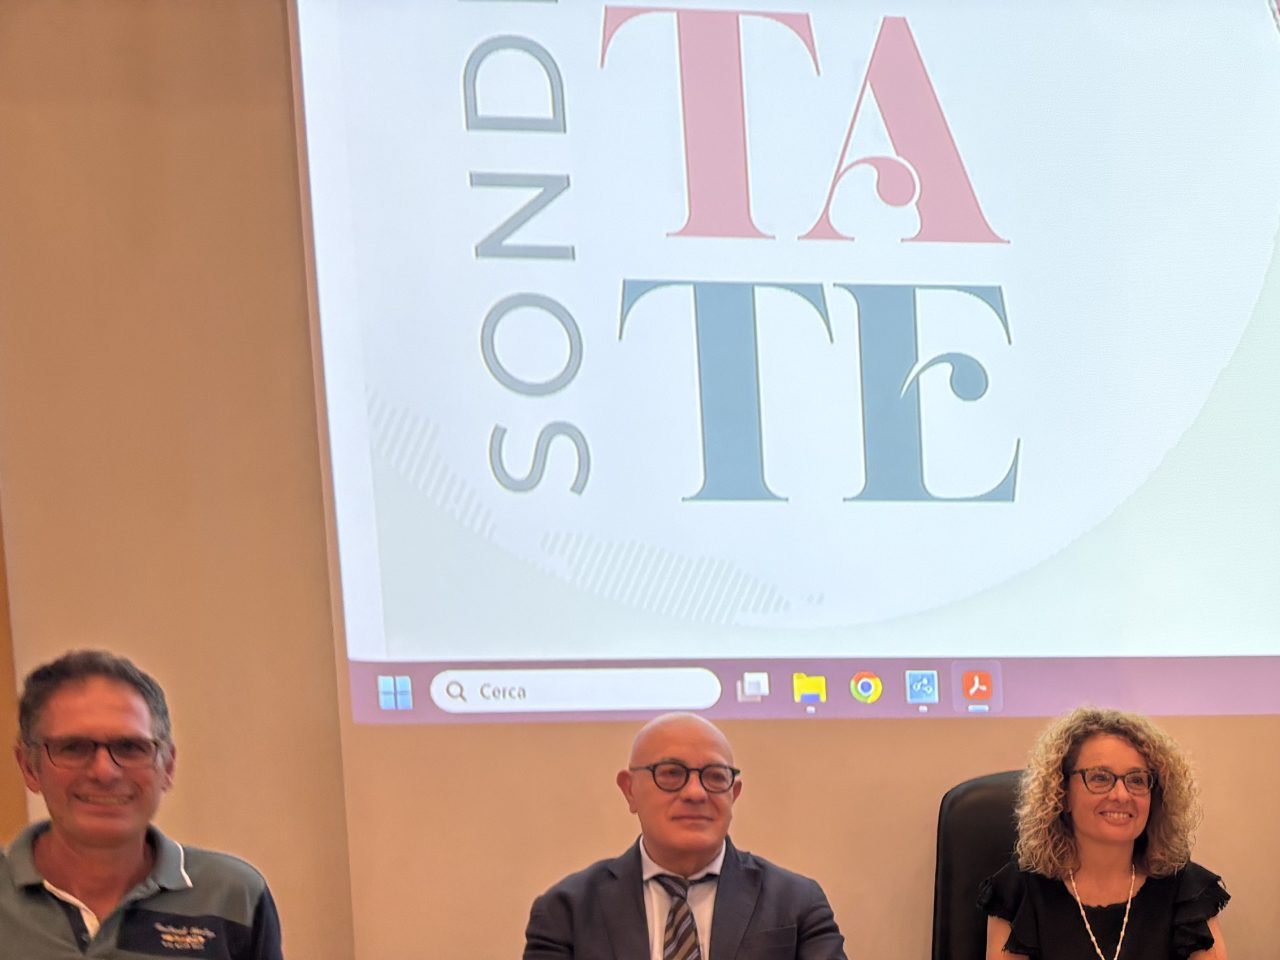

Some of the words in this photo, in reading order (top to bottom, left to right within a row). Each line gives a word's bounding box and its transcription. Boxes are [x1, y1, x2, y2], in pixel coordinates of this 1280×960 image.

[600, 5, 1011, 244] TA
[462, 0, 591, 497] SOND
[619, 279, 1020, 503] TE
[480, 682, 527, 700] Cerca
